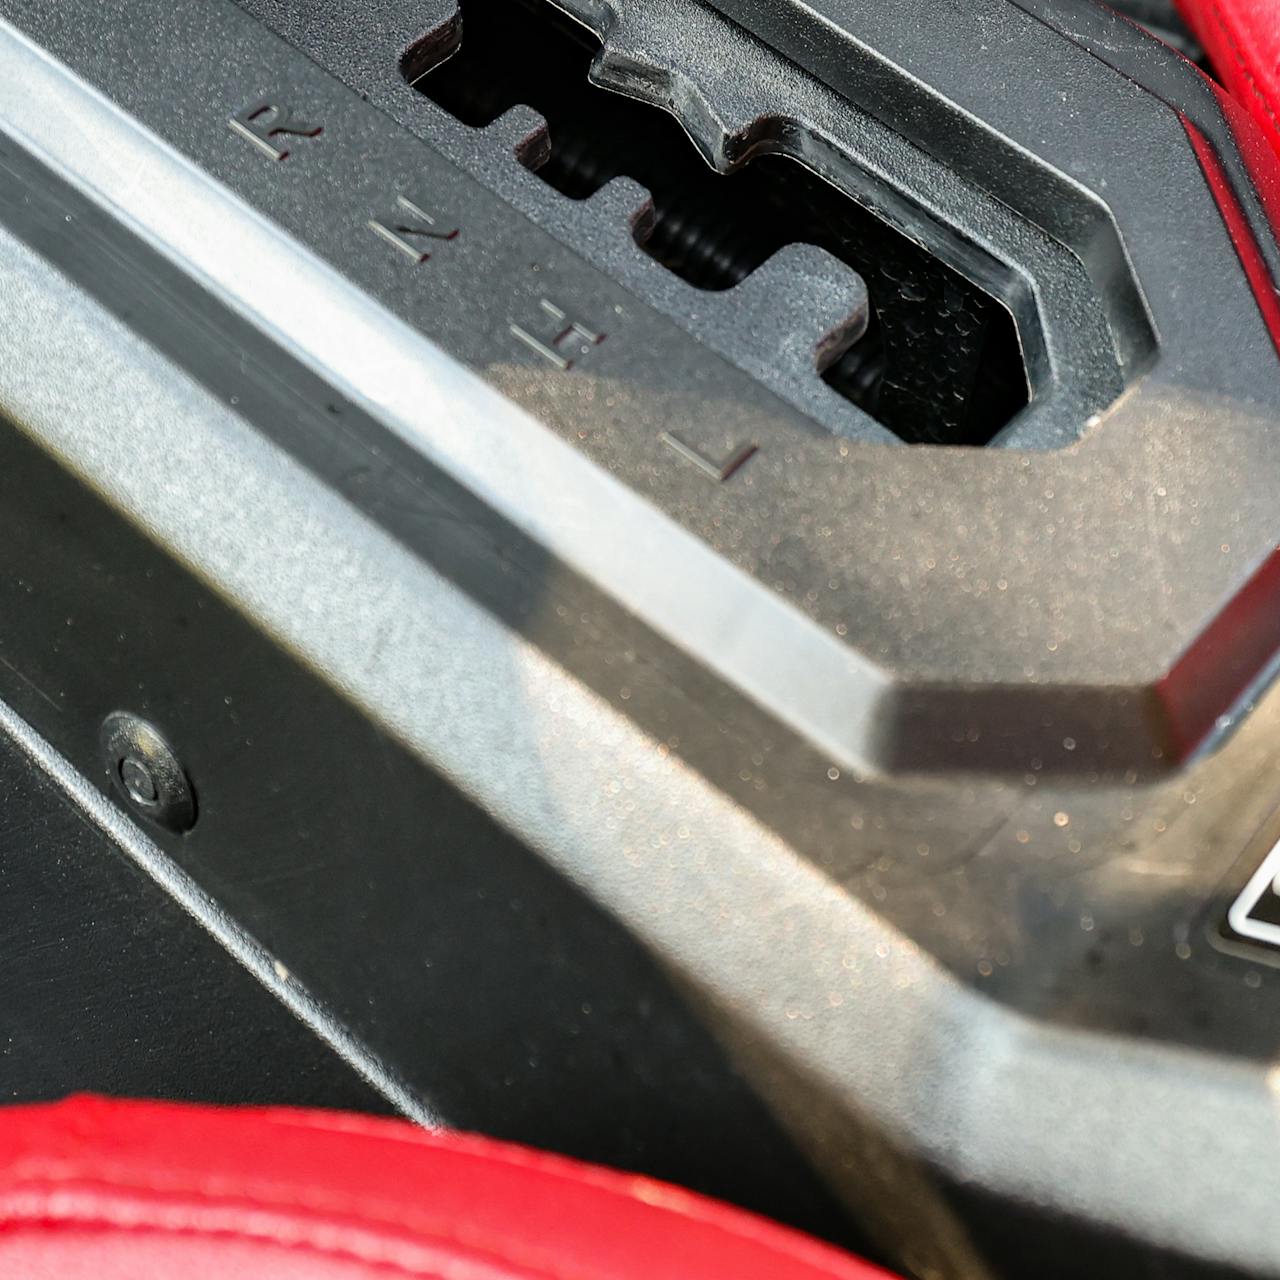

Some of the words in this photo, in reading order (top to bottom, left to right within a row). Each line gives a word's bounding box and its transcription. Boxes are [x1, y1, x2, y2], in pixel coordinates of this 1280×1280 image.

[228, 104, 324, 162] R
[368, 195, 461, 263] N
[509, 299, 607, 370] H
[662, 432, 760, 483] L
